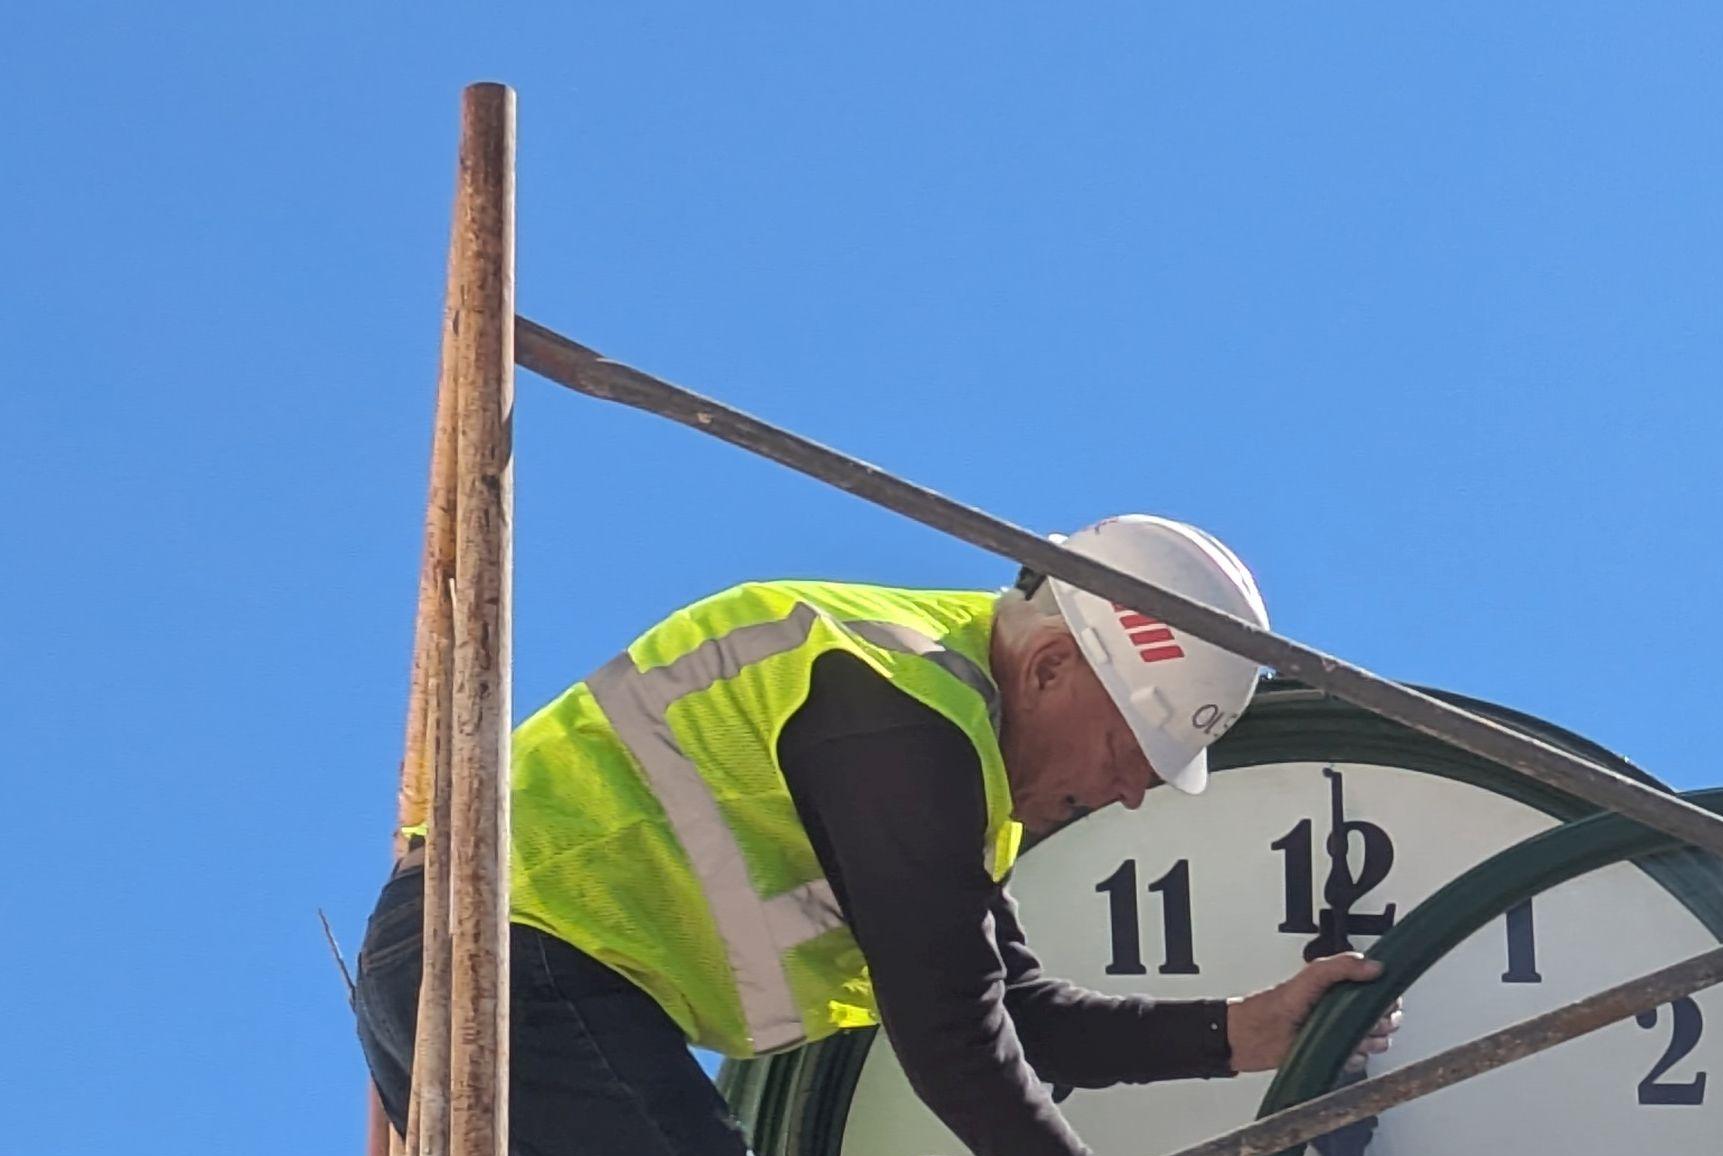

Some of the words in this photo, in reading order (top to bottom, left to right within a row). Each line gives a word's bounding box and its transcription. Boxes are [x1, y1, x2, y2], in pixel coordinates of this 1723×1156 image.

[1096, 859, 1200, 975] 11
[1271, 819, 1395, 935] 12
[1501, 899, 1542, 983] 1
[1636, 995, 1707, 1105] 2
